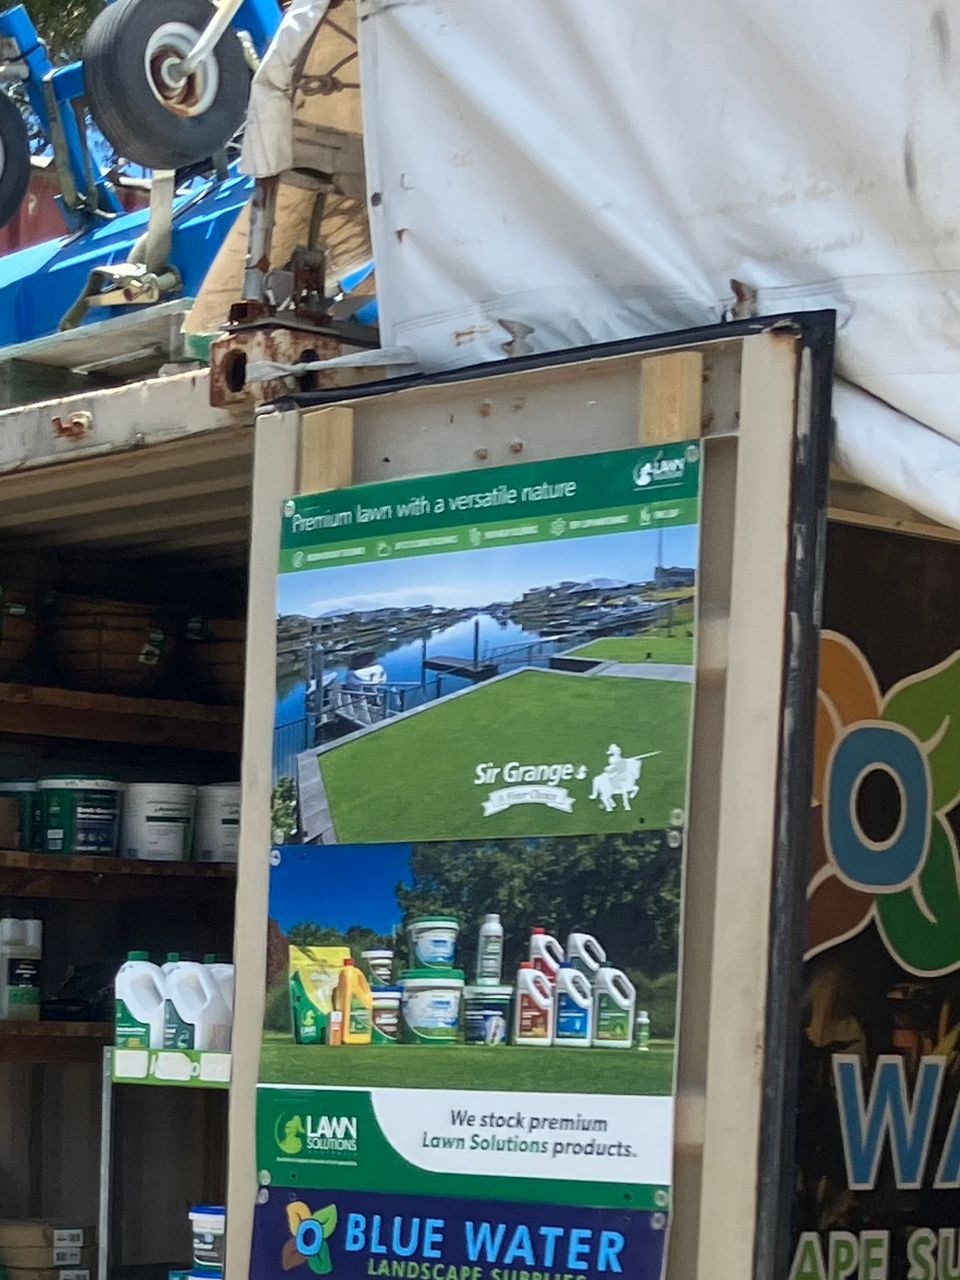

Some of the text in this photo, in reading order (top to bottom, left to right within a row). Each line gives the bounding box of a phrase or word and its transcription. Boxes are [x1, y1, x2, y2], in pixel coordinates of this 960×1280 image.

[291, 479, 577, 534] Premium lawn with a versatile nature
[474, 761, 575, 786] Sir Grange
[306, 1115, 357, 1139] LAWN
[451, 1108, 608, 1136] We stock premium
[306, 1137, 357, 1151] SOLUTIONS
[422, 1131, 638, 1162] Lawn Solutions products.
[345, 1214, 626, 1274] BLUE WATER
